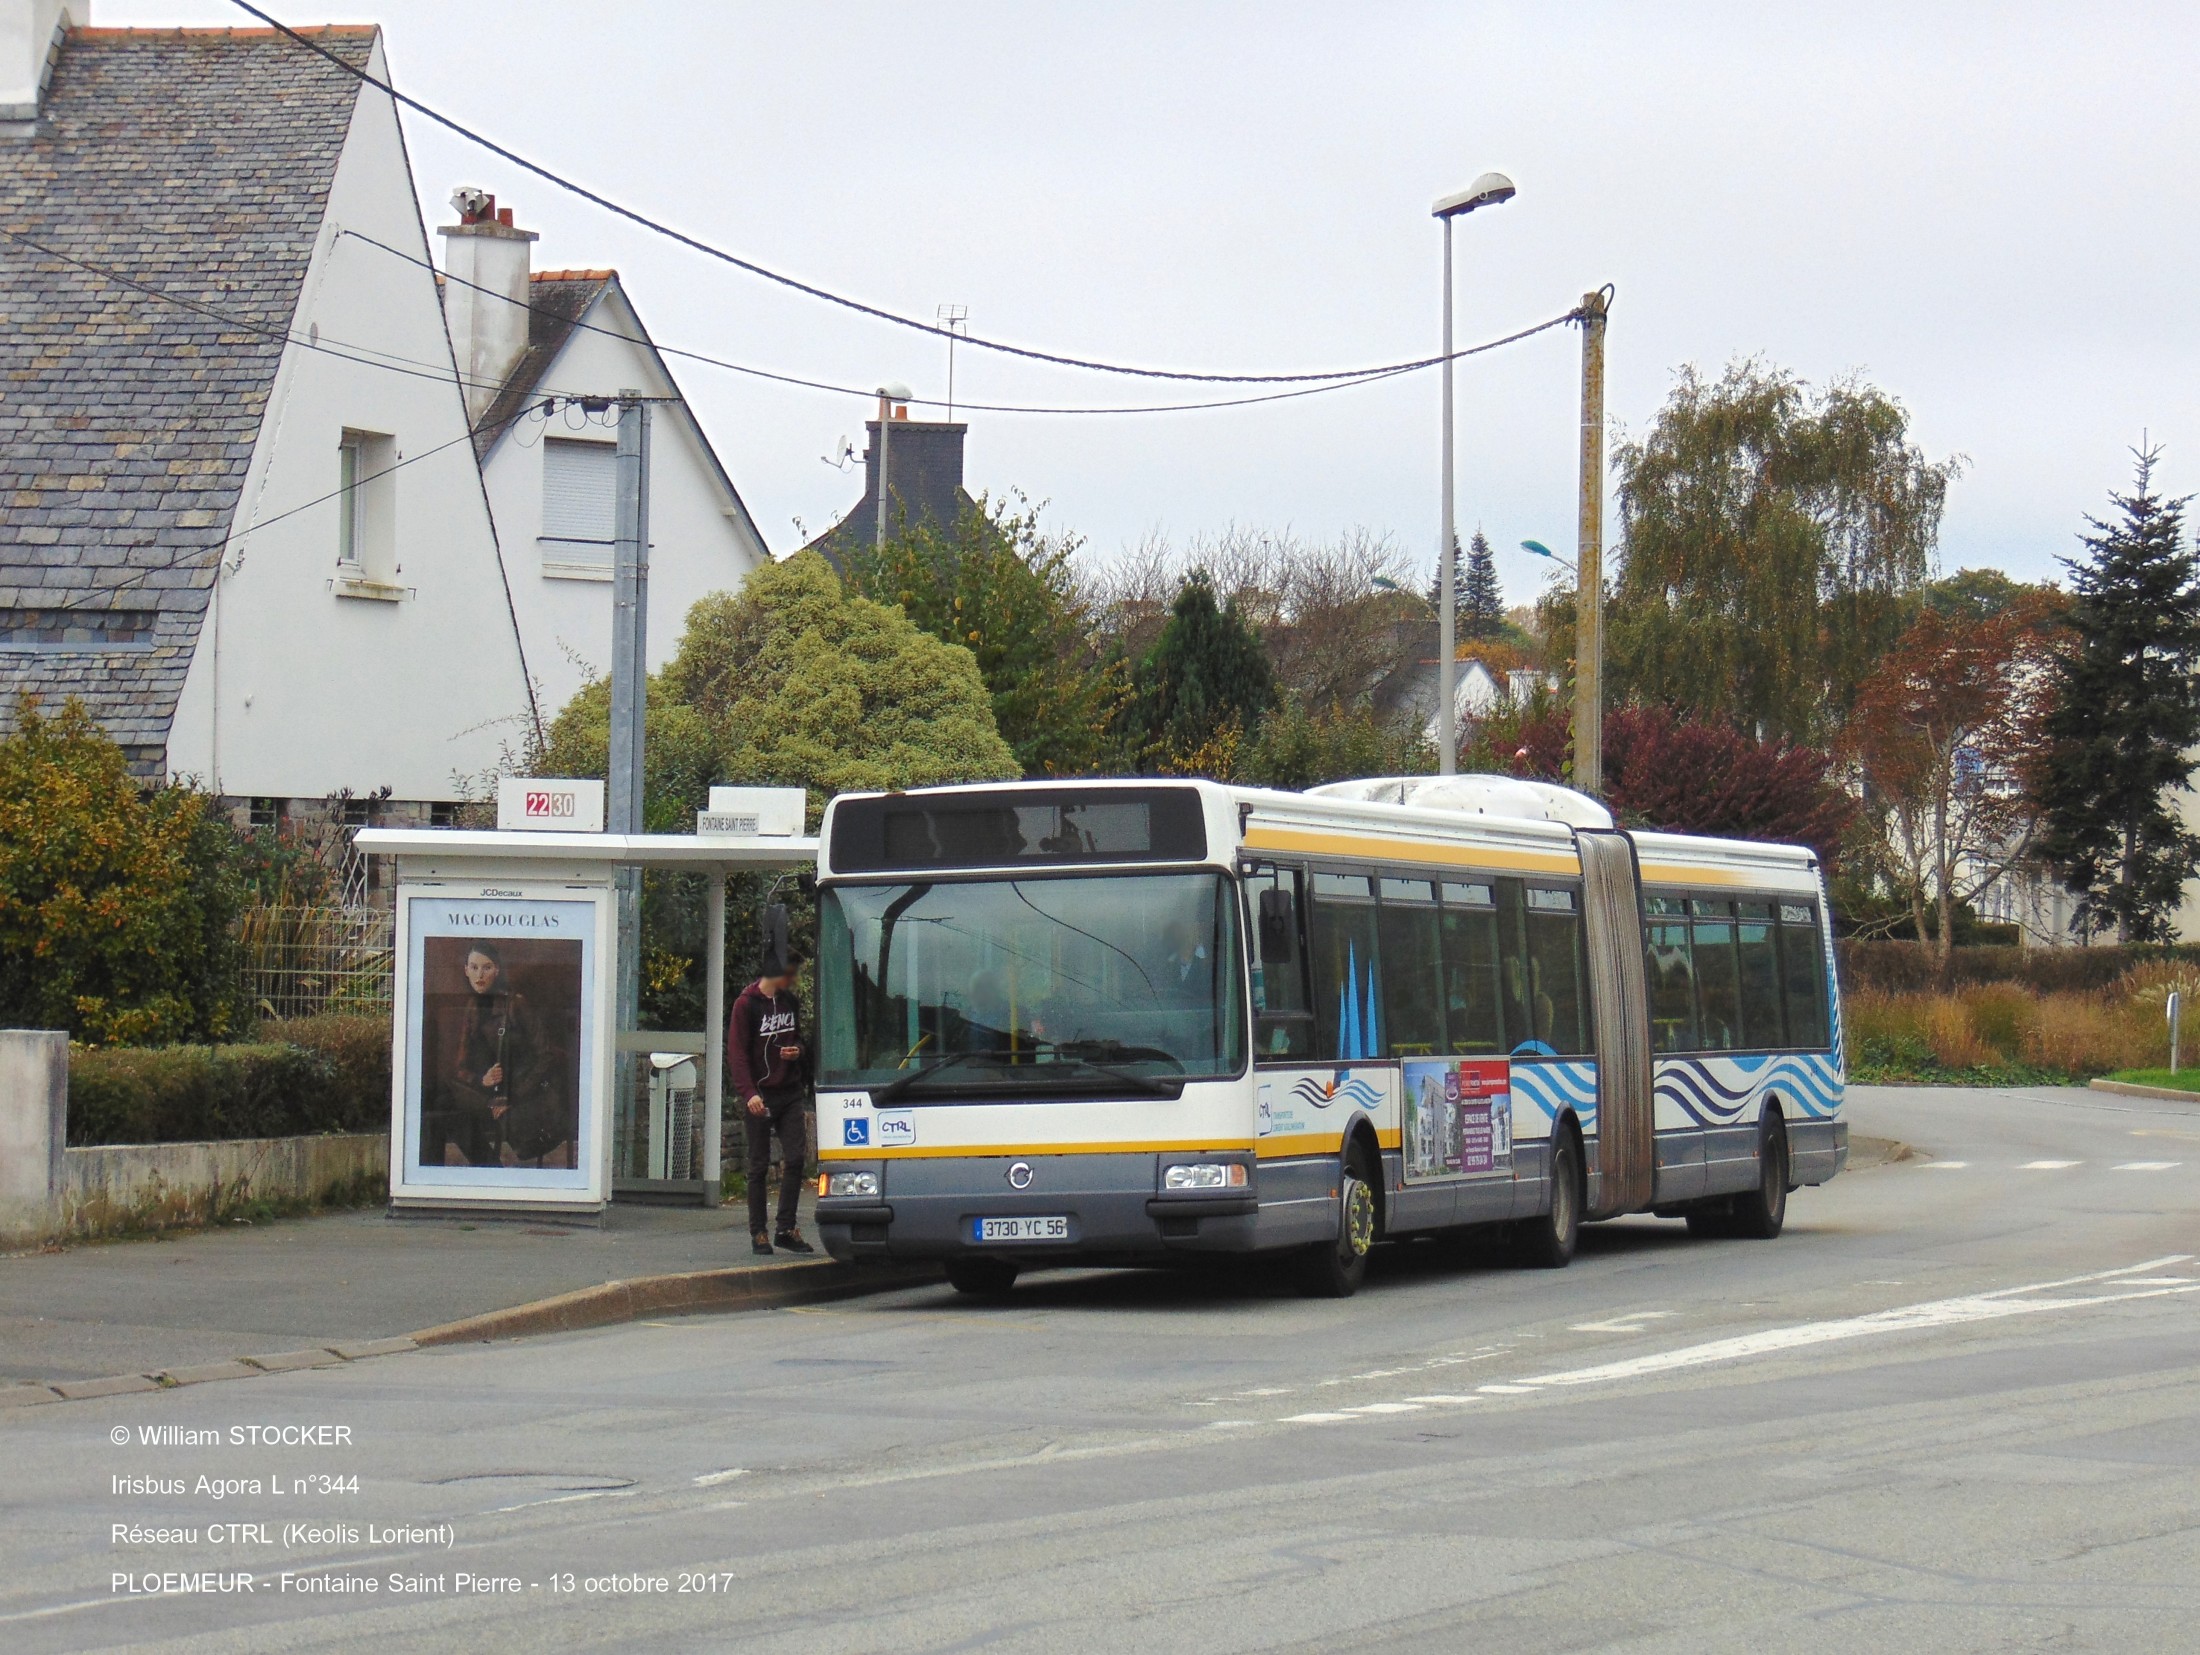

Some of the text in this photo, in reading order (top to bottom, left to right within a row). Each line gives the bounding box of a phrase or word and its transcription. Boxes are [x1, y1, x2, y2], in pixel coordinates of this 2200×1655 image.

[528, 794, 573, 816] 22 30
[703, 816, 756, 832] FONTAINE SAINT PIERRE
[480, 888, 523, 897] JCDecaux
[484, 913, 559, 928] DOUGLAS
[843, 1098, 862, 1109] 344
[882, 1120, 911, 1133] CTRL
[986, 1219, 1064, 1236] 3730 YC 56
